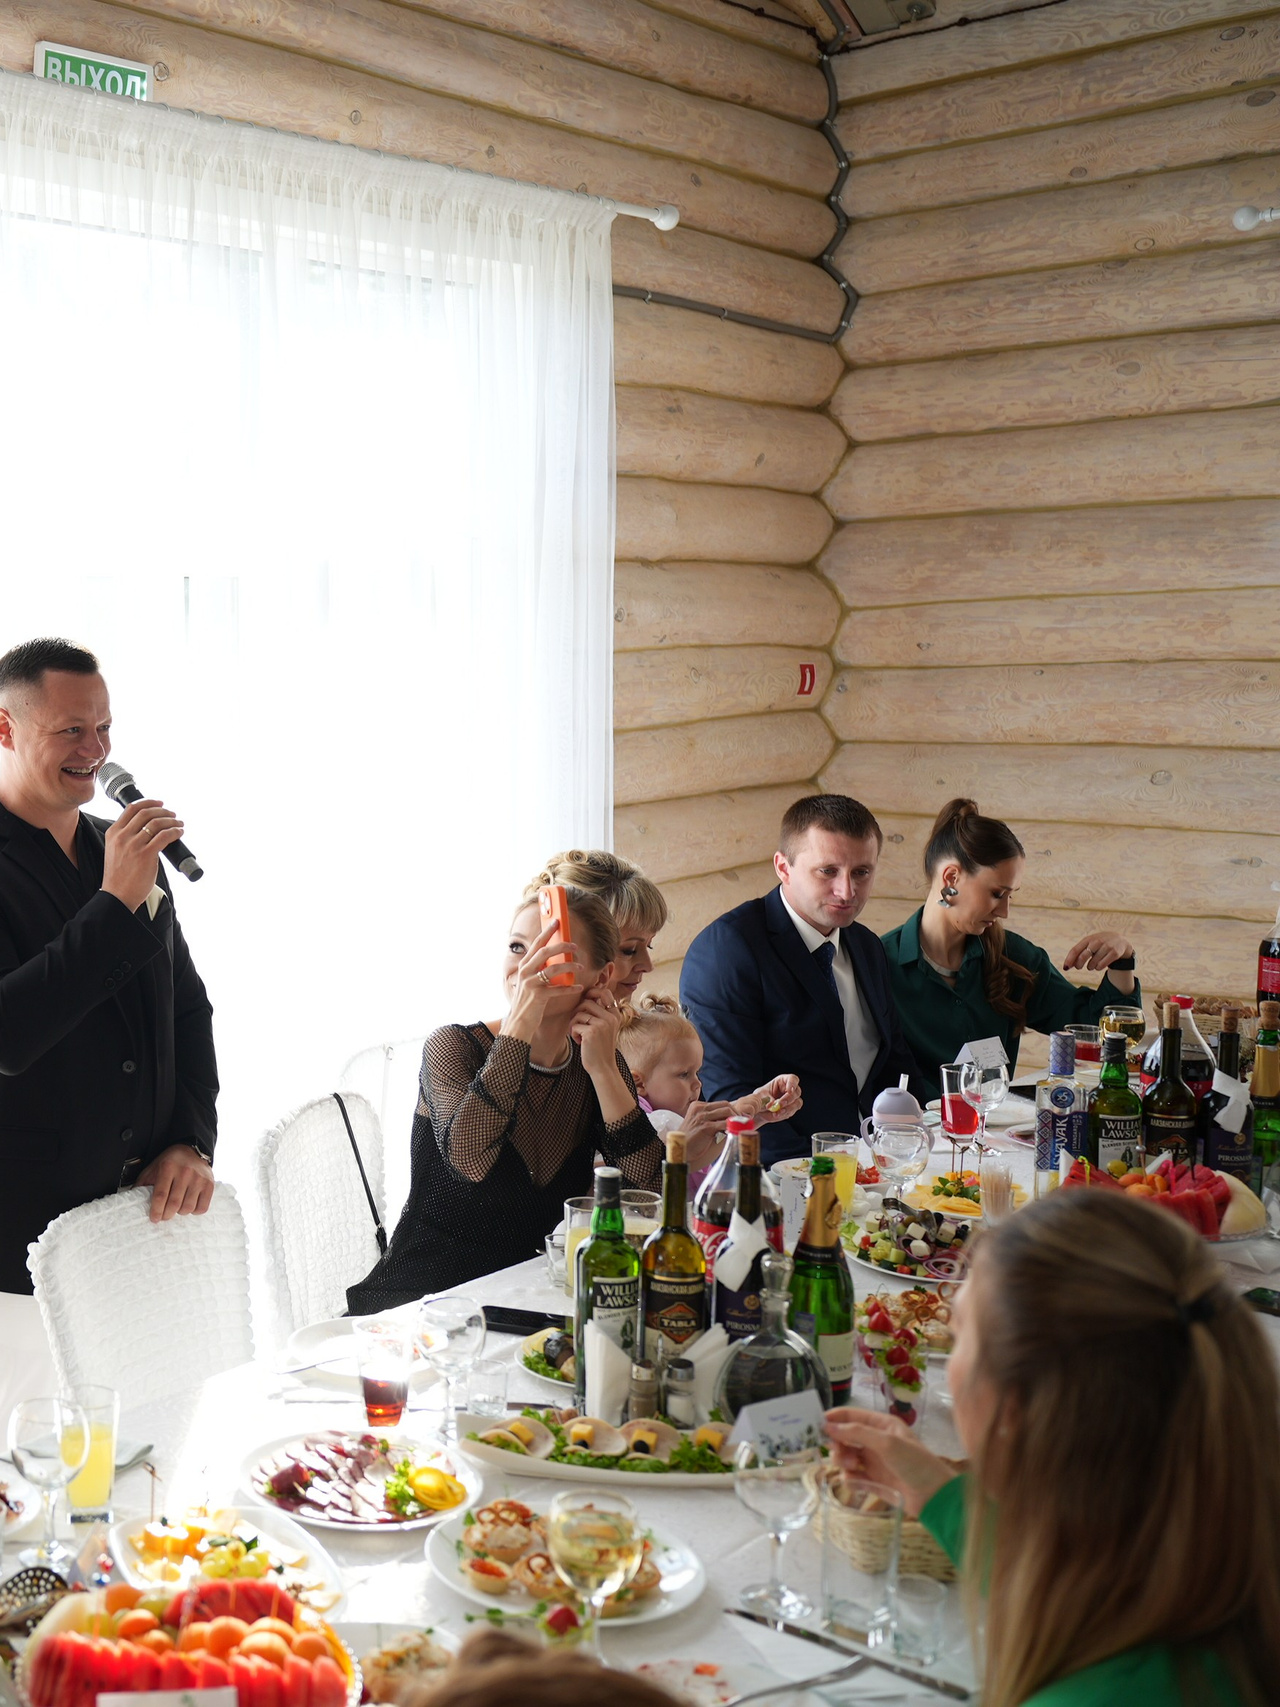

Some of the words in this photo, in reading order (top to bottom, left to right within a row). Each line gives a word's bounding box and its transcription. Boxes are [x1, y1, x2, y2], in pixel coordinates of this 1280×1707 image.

[47, 56, 141, 101] ВЫХОД
[1105, 1120, 1140, 1130] WILLIA
[596, 1293, 638, 1308] LAWSO
